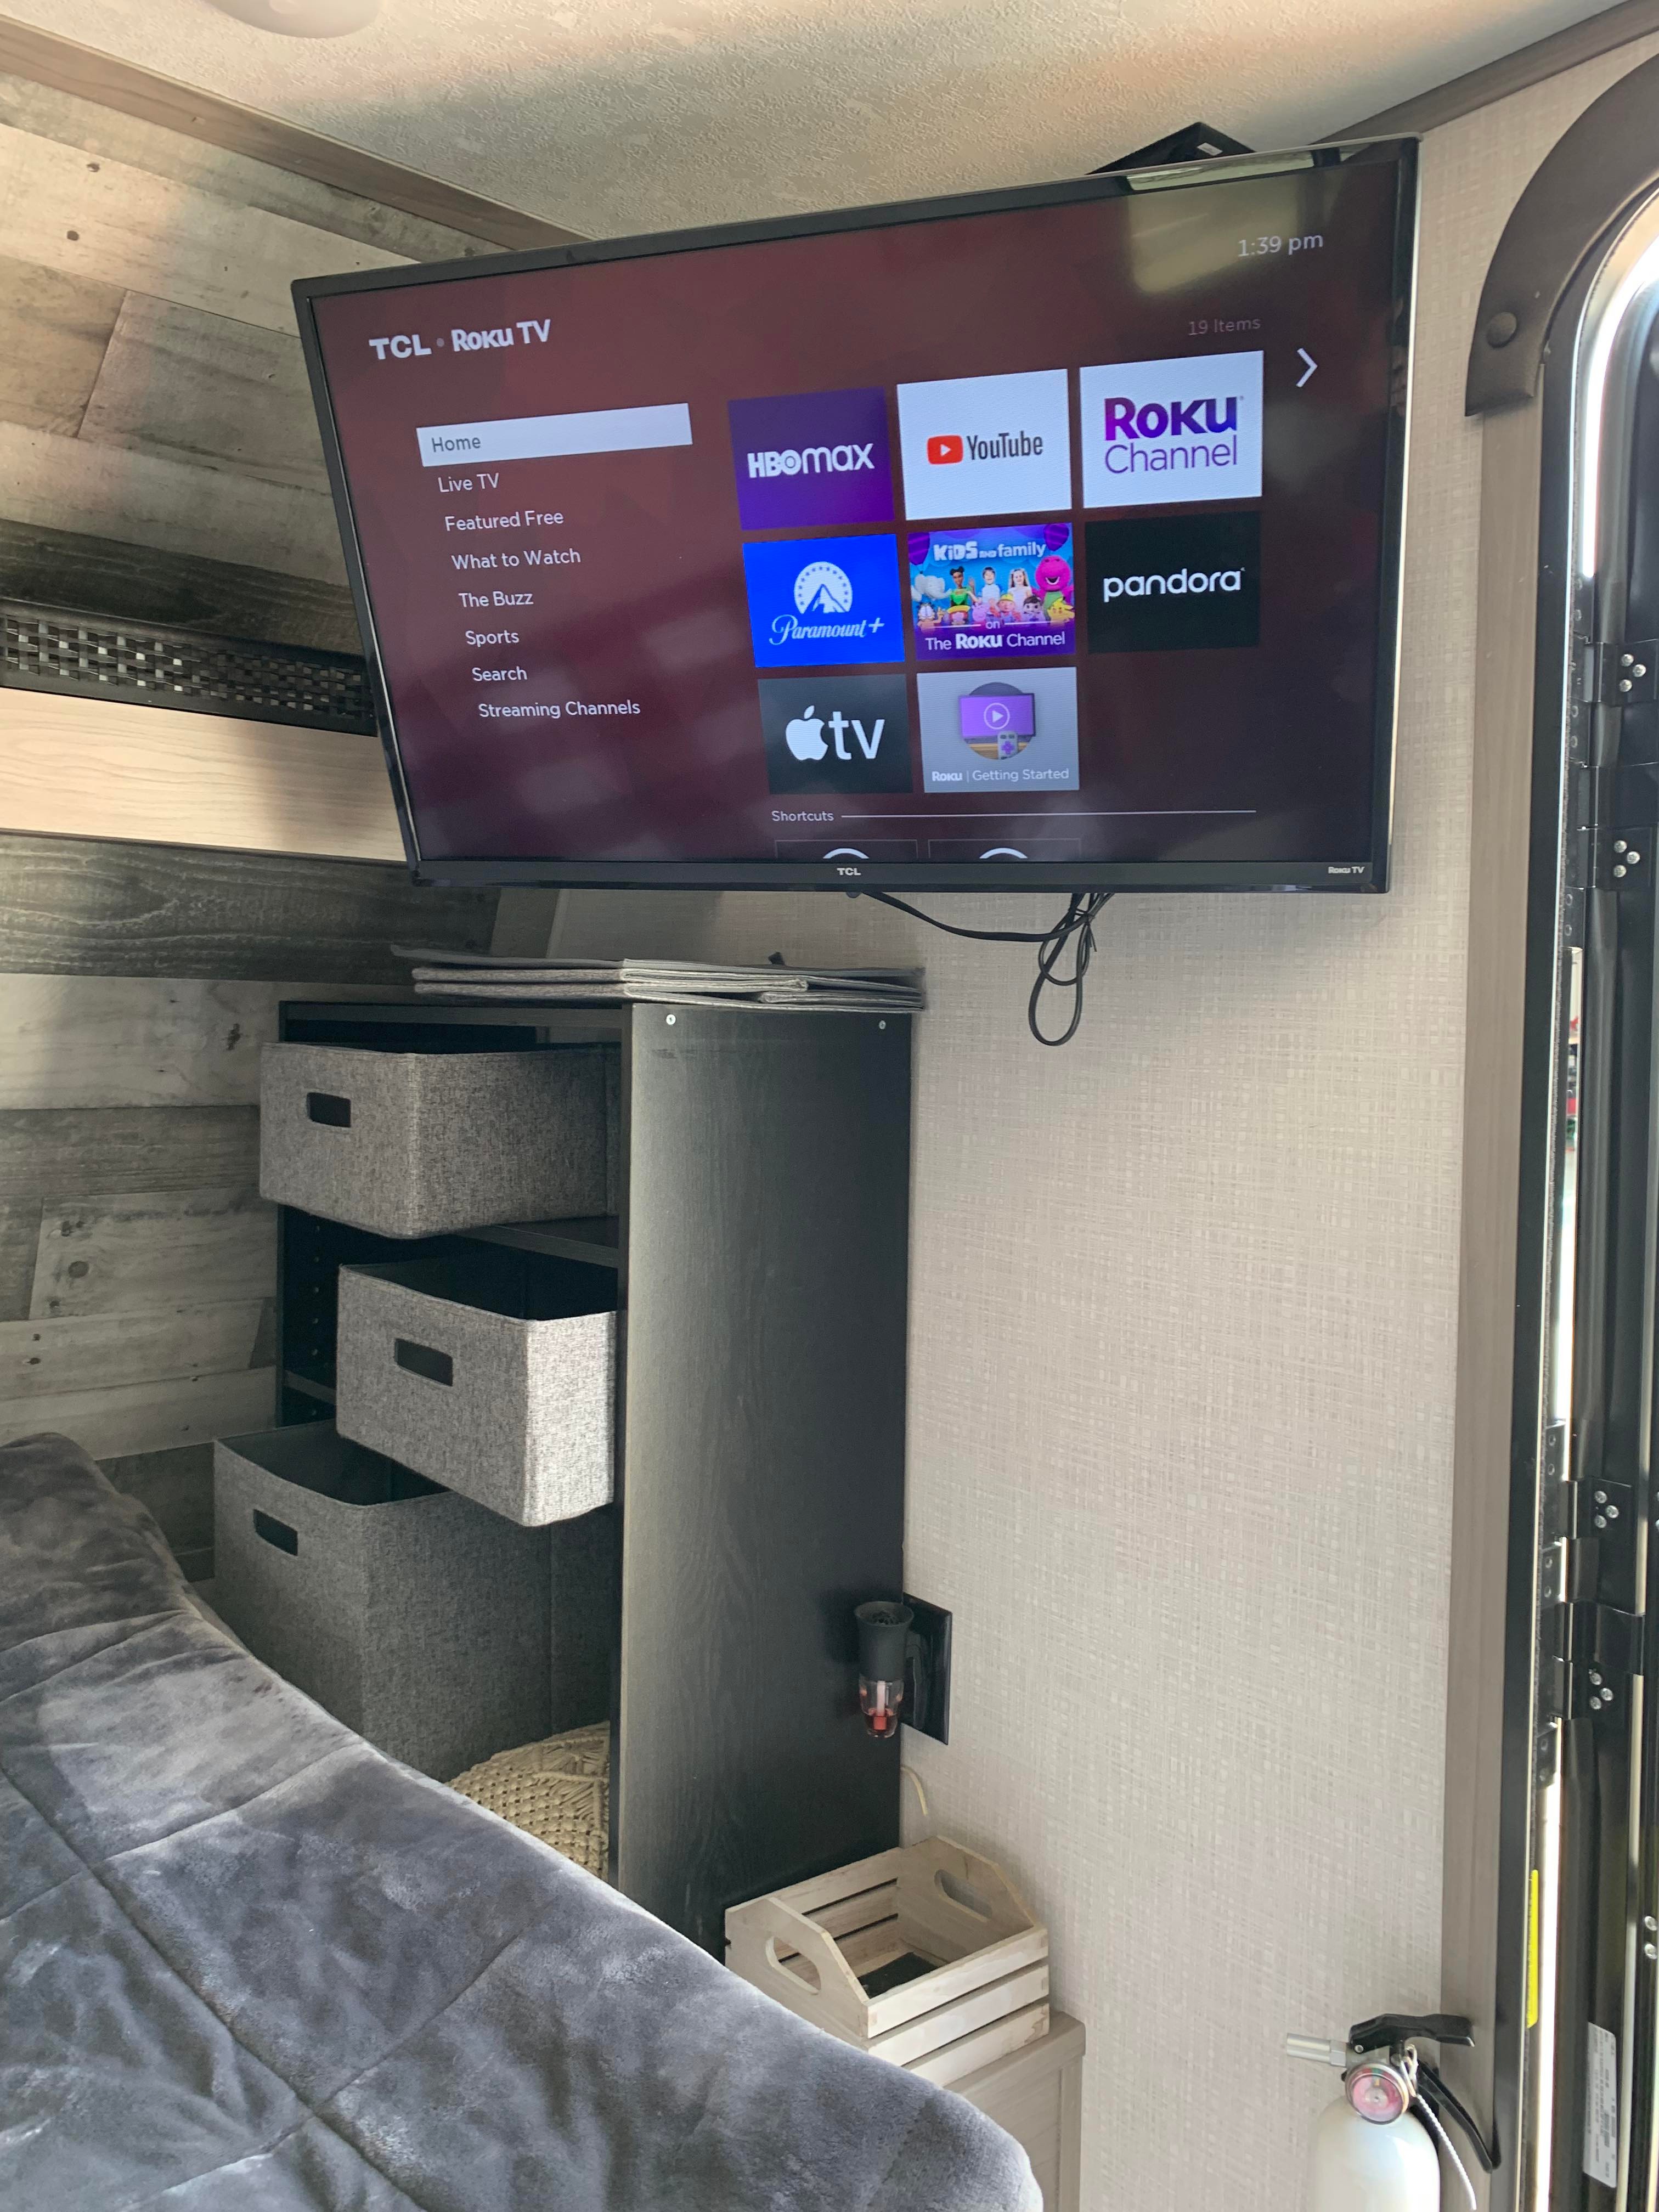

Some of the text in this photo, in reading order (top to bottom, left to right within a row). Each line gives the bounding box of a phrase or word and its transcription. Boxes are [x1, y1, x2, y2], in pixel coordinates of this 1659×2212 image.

[1238, 234, 1323, 257] 1:39 pm
[1188, 317, 1261, 335] 19 Items
[368, 319, 551, 360] TCL Roku TV
[1104, 396, 1238, 441] Roku
[431, 435, 481, 454] Home
[966, 430, 1043, 461] YouTube
[1104, 435, 1238, 473] Channel
[438, 472, 500, 493] Live TV
[445, 510, 565, 532] Featured Free
[451, 548, 582, 571] What to Watch
[997, 541, 1047, 558] family
[1103, 568, 1242, 603] pandora
[458, 590, 534, 608] The Buzz
[985, 620, 1001, 630] on
[465, 629, 520, 647] Sports
[925, 631, 1065, 651] The Roku Channel
[471, 665, 528, 682] Search
[478, 699, 641, 719] Streaming Channels
[828, 710, 885, 761] tv
[932, 768, 1070, 783] Roku Getting Started
[771, 810, 834, 822] Shortcuts
[837, 867, 861, 876] TCL
